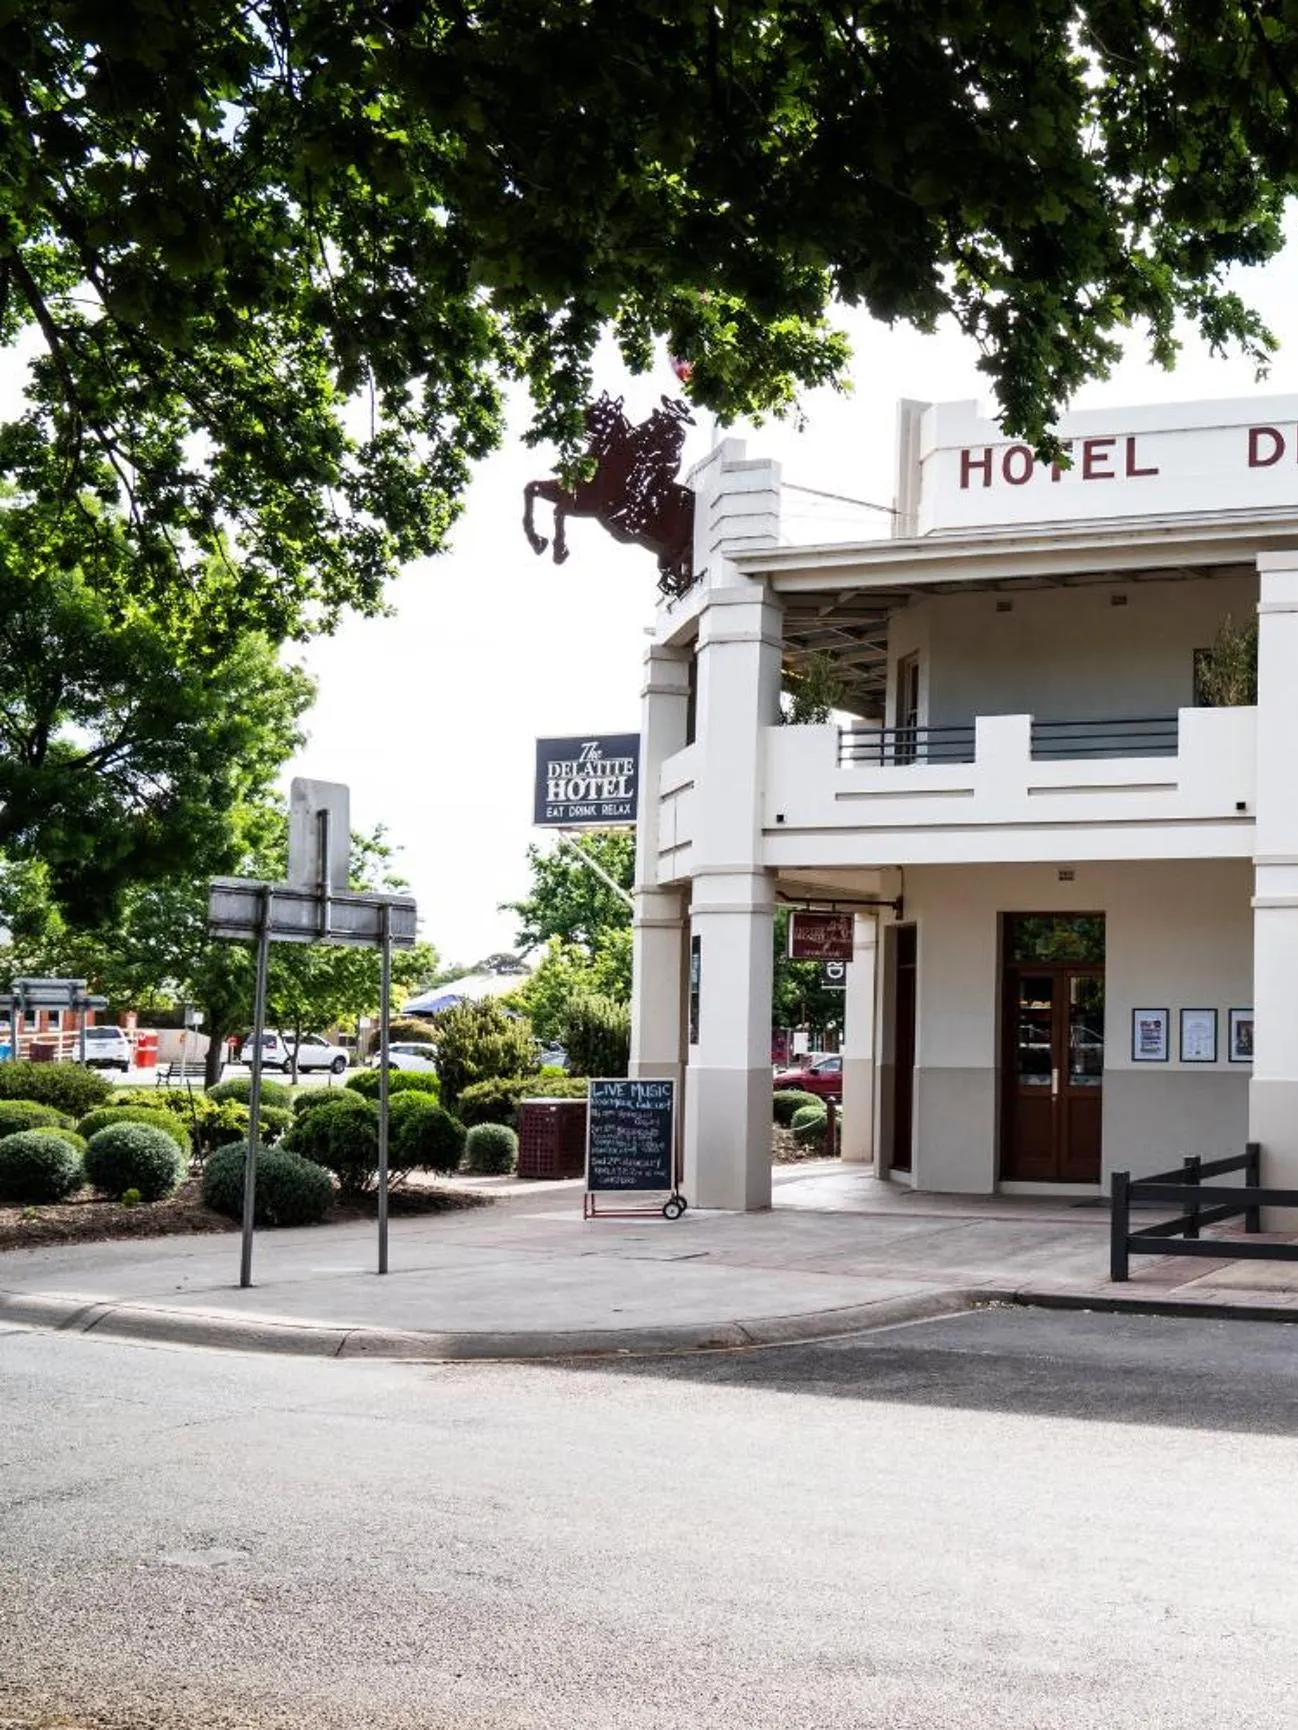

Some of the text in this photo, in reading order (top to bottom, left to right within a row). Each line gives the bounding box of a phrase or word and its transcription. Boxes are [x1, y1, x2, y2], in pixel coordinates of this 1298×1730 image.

[579, 741, 603, 762] The
[547, 757, 634, 778] DELATITE
[546, 776, 634, 802] HOTEL
[546, 803, 631, 818] EAT DRINK RELAX
[592, 1082, 672, 1102] LIVE MUSIC
